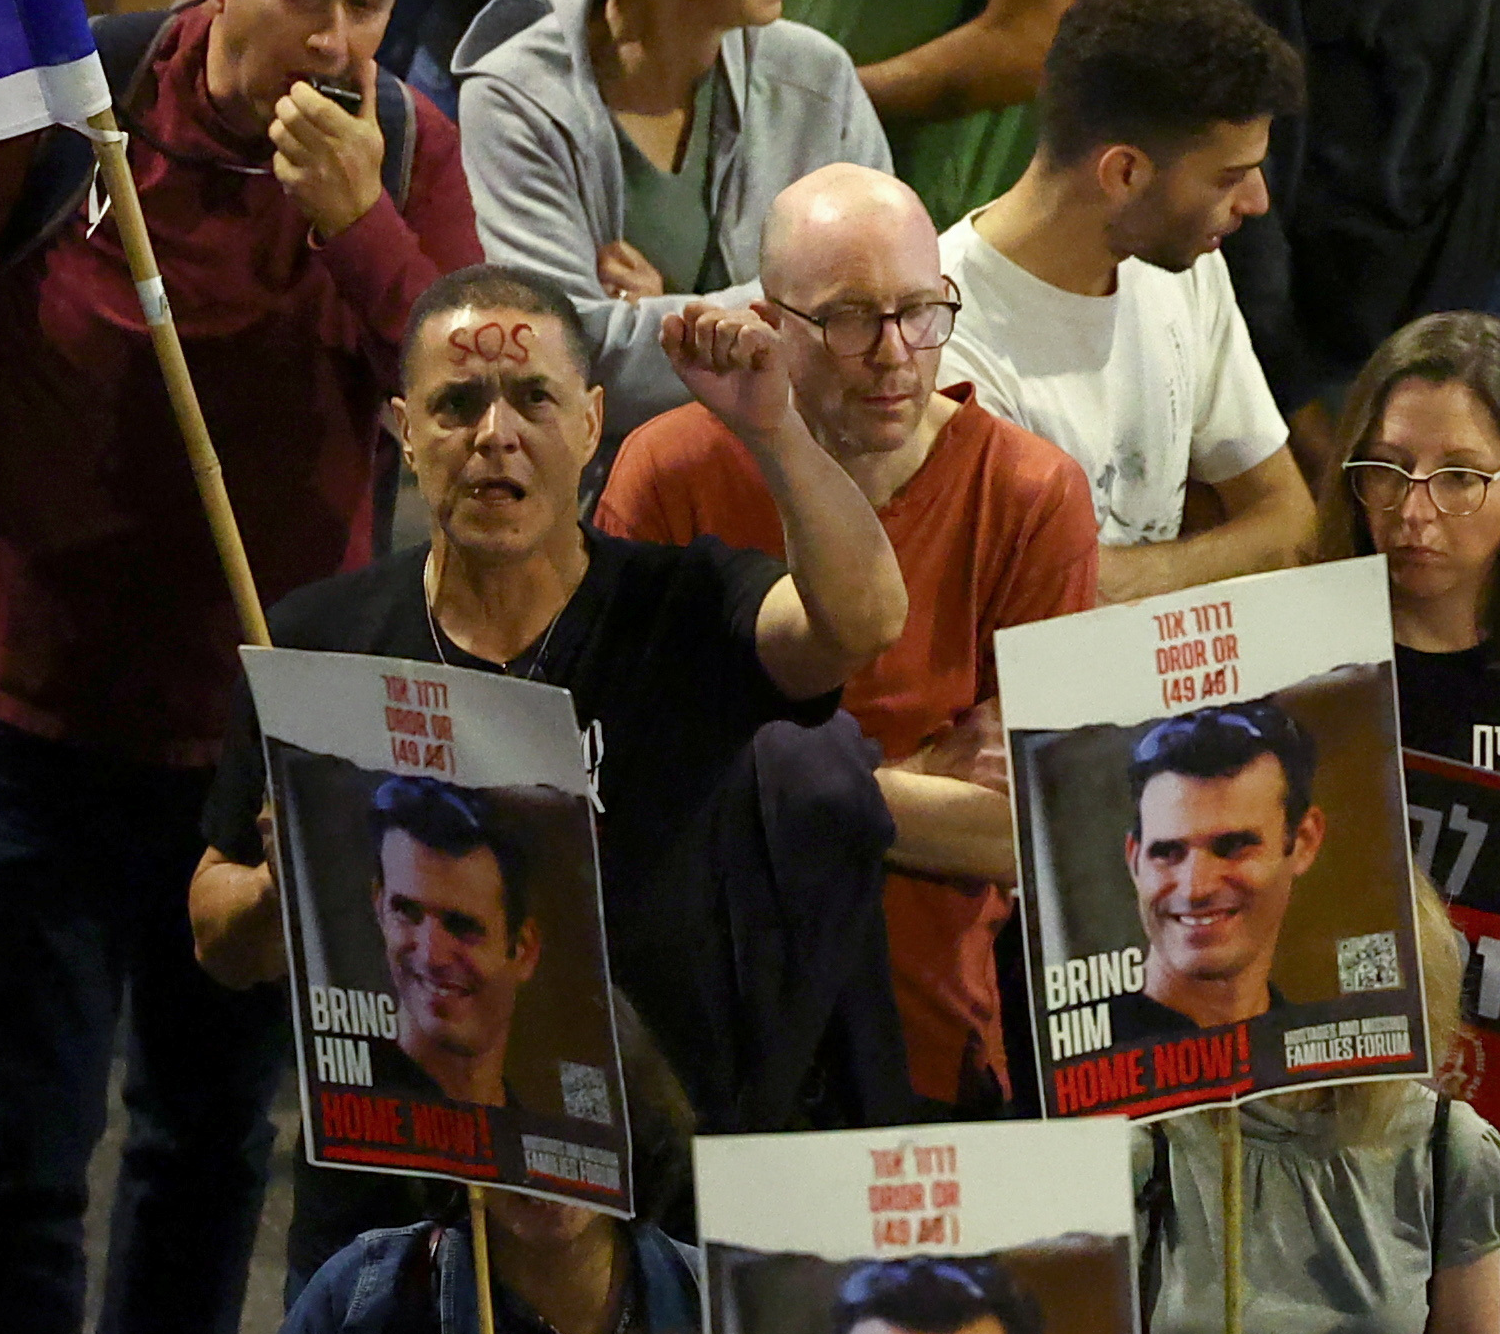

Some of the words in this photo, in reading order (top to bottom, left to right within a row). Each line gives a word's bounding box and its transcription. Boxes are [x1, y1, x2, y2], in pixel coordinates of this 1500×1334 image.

[448, 322, 534, 366] SOS
[1153, 610, 1187, 641] אור
[1190, 602, 1232, 634] דרור
[1156, 639, 1208, 675] DROR
[1212, 634, 1239, 664] OR
[1044, 946, 1145, 1012] BRING
[309, 985, 399, 1040] BRING
[1047, 1002, 1114, 1061] HIM
[314, 1035, 374, 1087] HIM
[1053, 1048, 1148, 1115] HOME
[1153, 1023, 1252, 1089] NOW!
[1285, 1035, 1355, 1068] FAMILIES
[1356, 1030, 1412, 1058] FORUM
[321, 1091, 407, 1145] HOME
